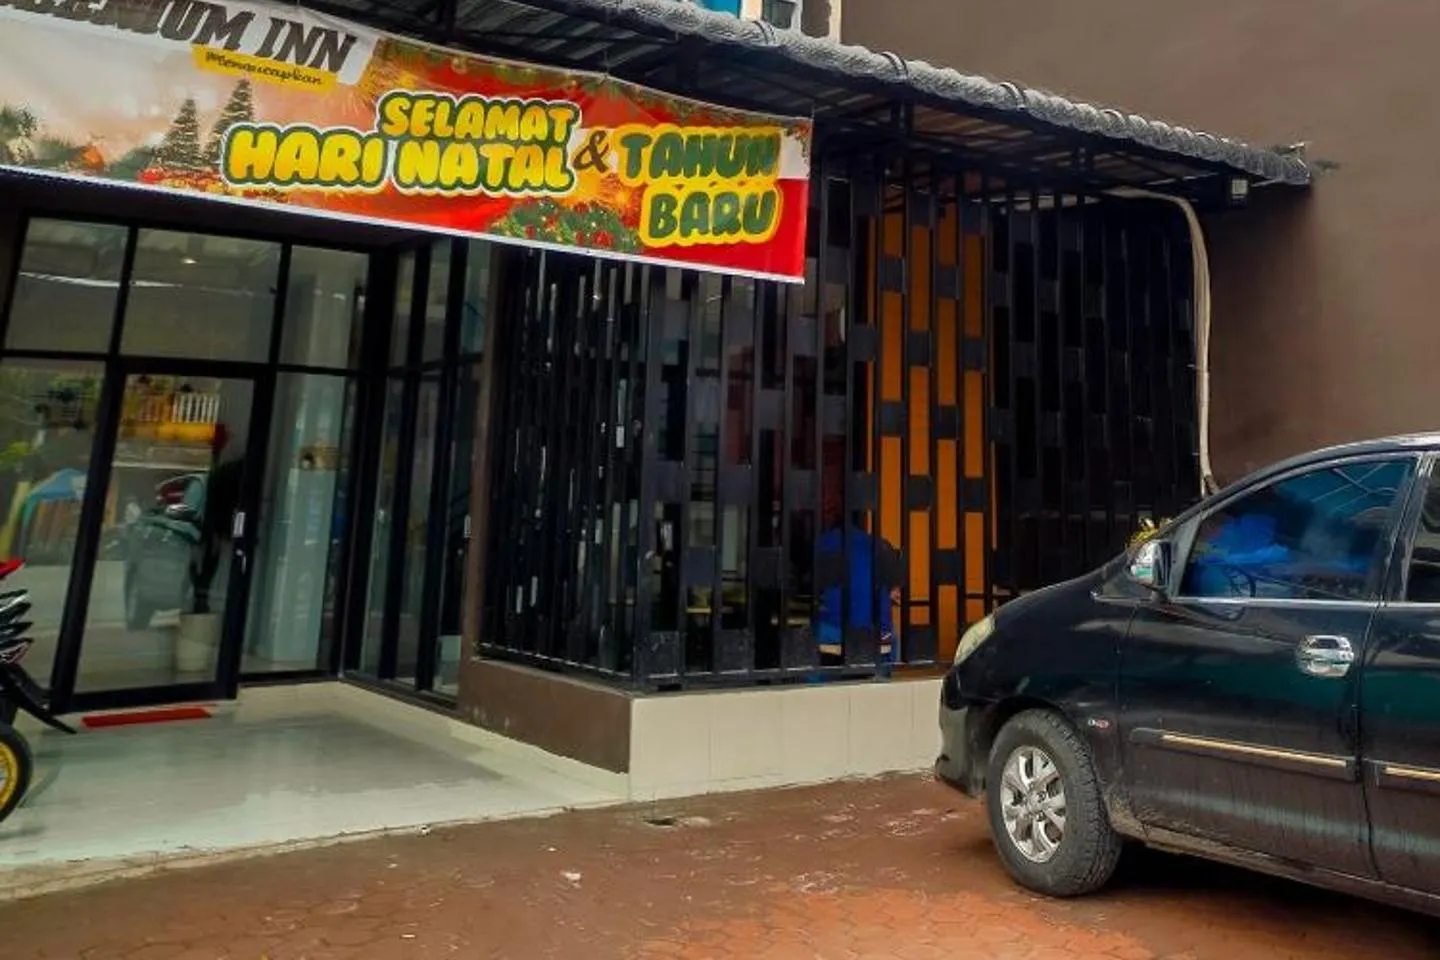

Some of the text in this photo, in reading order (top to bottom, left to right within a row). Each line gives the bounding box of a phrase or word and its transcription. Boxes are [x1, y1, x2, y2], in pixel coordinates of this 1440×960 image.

[254, 17, 357, 73] INN
[380, 94, 577, 144] SELAMAT
[226, 128, 781, 190] HARI NATAL & TAHUN
[648, 190, 778, 239] BARU
